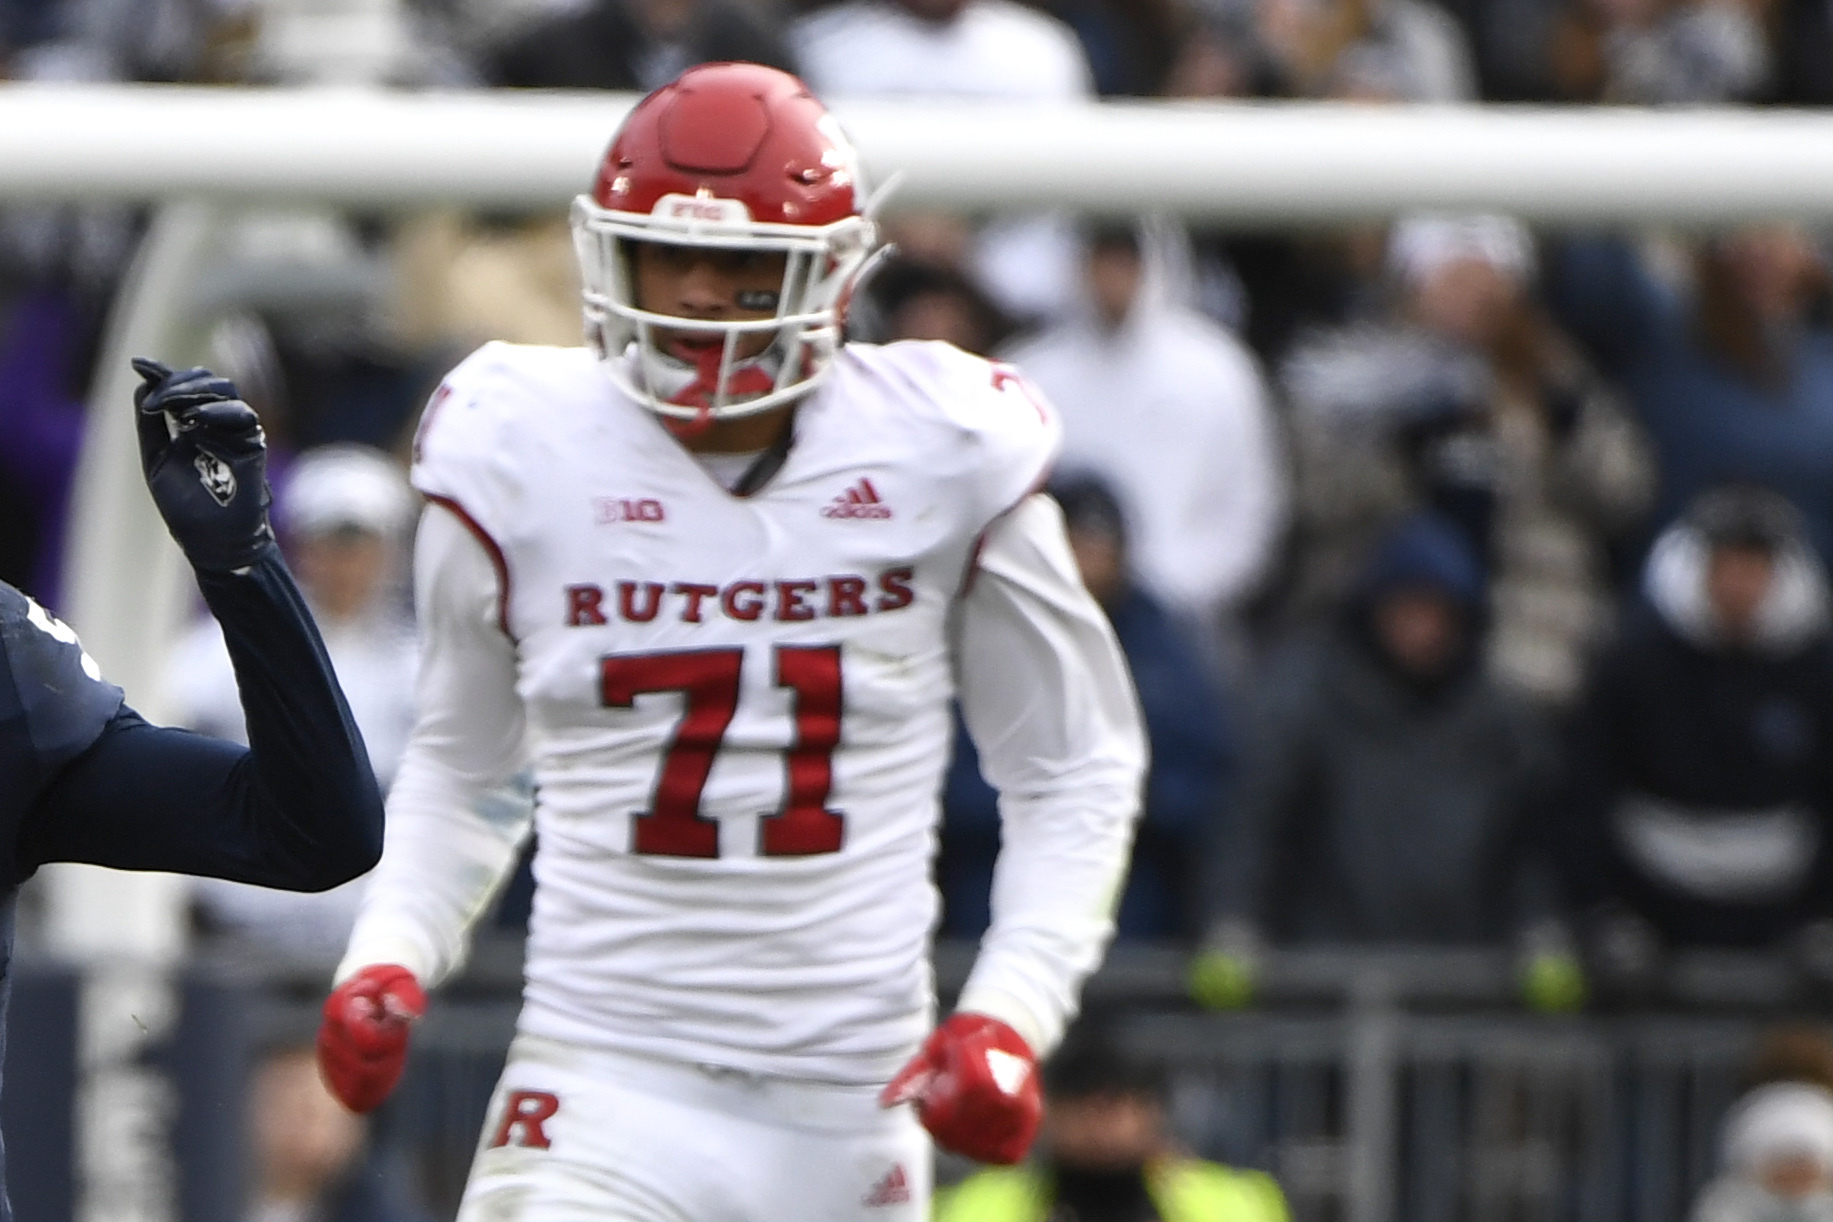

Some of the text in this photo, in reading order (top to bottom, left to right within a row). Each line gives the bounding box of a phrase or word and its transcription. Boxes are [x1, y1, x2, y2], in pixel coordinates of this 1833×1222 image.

[564, 565, 916, 627] RUTGERS
[598, 644, 845, 859] 71
[487, 1090, 559, 1151] R
